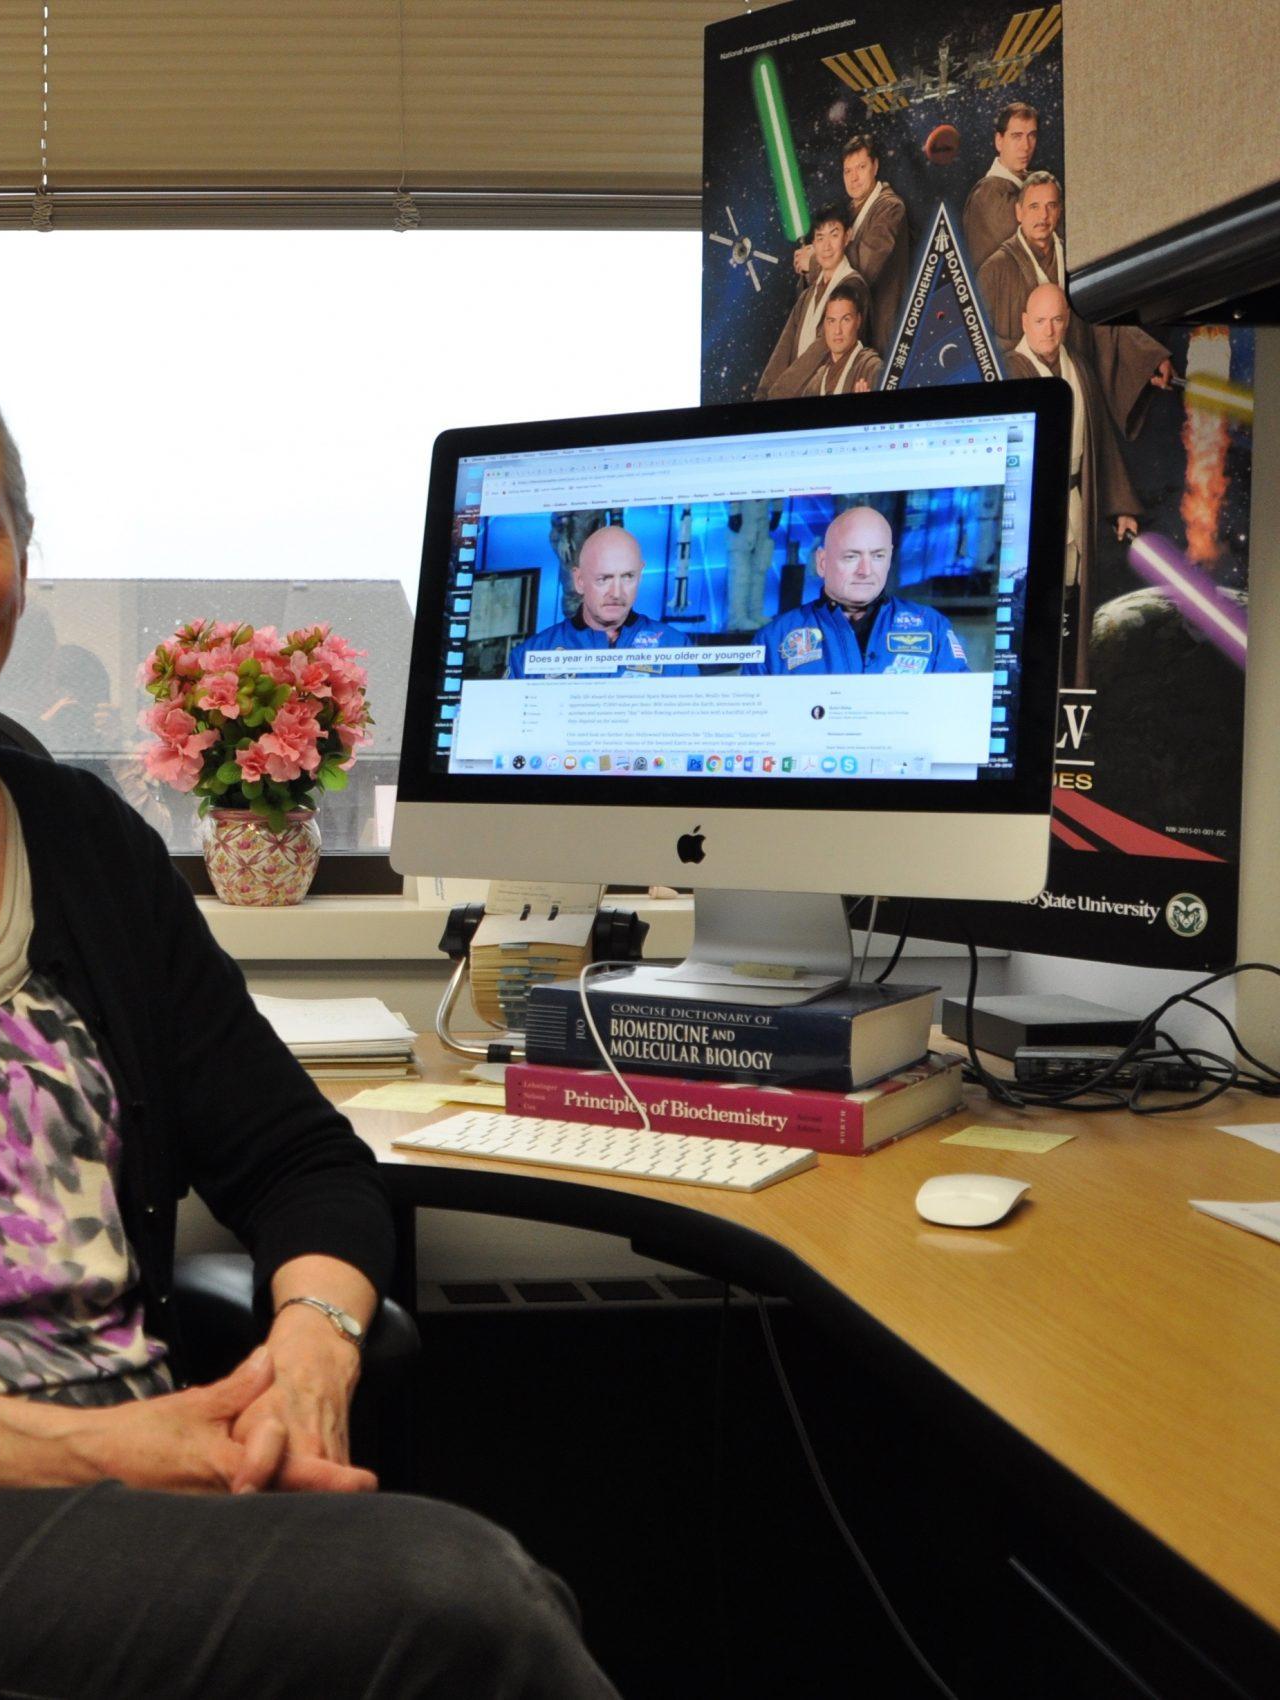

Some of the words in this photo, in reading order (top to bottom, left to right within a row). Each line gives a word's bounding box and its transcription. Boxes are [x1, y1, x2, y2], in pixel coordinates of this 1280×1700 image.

[720, 48, 743, 60] National
[743, 40, 778, 53] Aeronautics
[778, 35, 790, 45] and
[790, 30, 811, 41] Space
[811, 18, 856, 36] Administration
[904, 253, 939, 337] КОНОНЕНКО
[944, 250, 970, 304] ВОЛКОВ
[963, 306, 995, 383] КОРНИЕНКО
[529, 654, 552, 664] Does
[562, 656, 582, 666] year
[585, 654, 593, 662] in
[595, 655, 623, 665] space
[626, 652, 652, 662] make
[655, 653, 672, 663] you
[675, 651, 699, 661] older
[715, 650, 762, 662] younger?
[690, 759, 702, 769] Ps
[1039, 890, 1077, 909] State
[1078, 896, 1160, 925] University
[611, 1003, 666, 1016] CONCISE
[671, 1009, 752, 1024] DICTIONARY
[755, 1015, 773, 1025] OF
[610, 1019, 709, 1044] BIOMEDICINE
[712, 1029, 735, 1042] AND
[610, 1040, 701, 1064] MOLECULAR
[706, 1048, 773, 1070] BIOLOGY
[563, 1090, 648, 1115] Principles
[650, 1100, 669, 1116] of
[671, 1101, 788, 1132] Biochemistry
